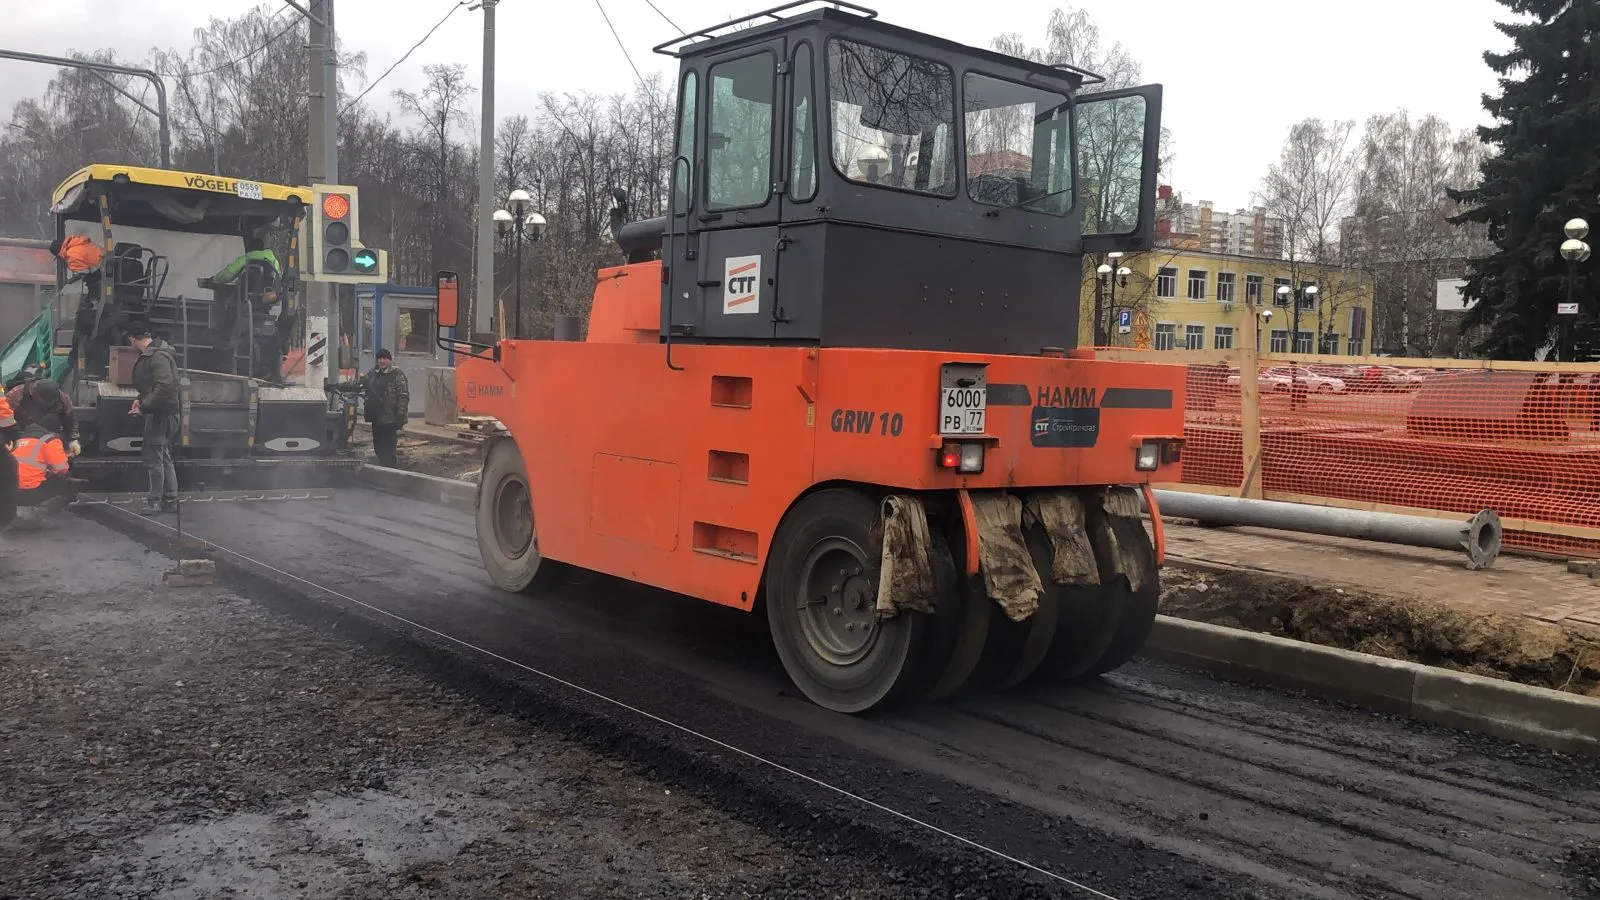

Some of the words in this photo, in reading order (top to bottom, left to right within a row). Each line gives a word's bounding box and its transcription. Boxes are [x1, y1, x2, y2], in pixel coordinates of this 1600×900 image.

[184, 176, 238, 192] VÖGELE
[478, 384, 504, 397] HAMM
[947, 389, 981, 408] 6000
[1037, 385, 1097, 407] HAMM
[831, 408, 876, 435] GRW
[880, 412, 904, 437] 10
[969, 411, 983, 426] 77
